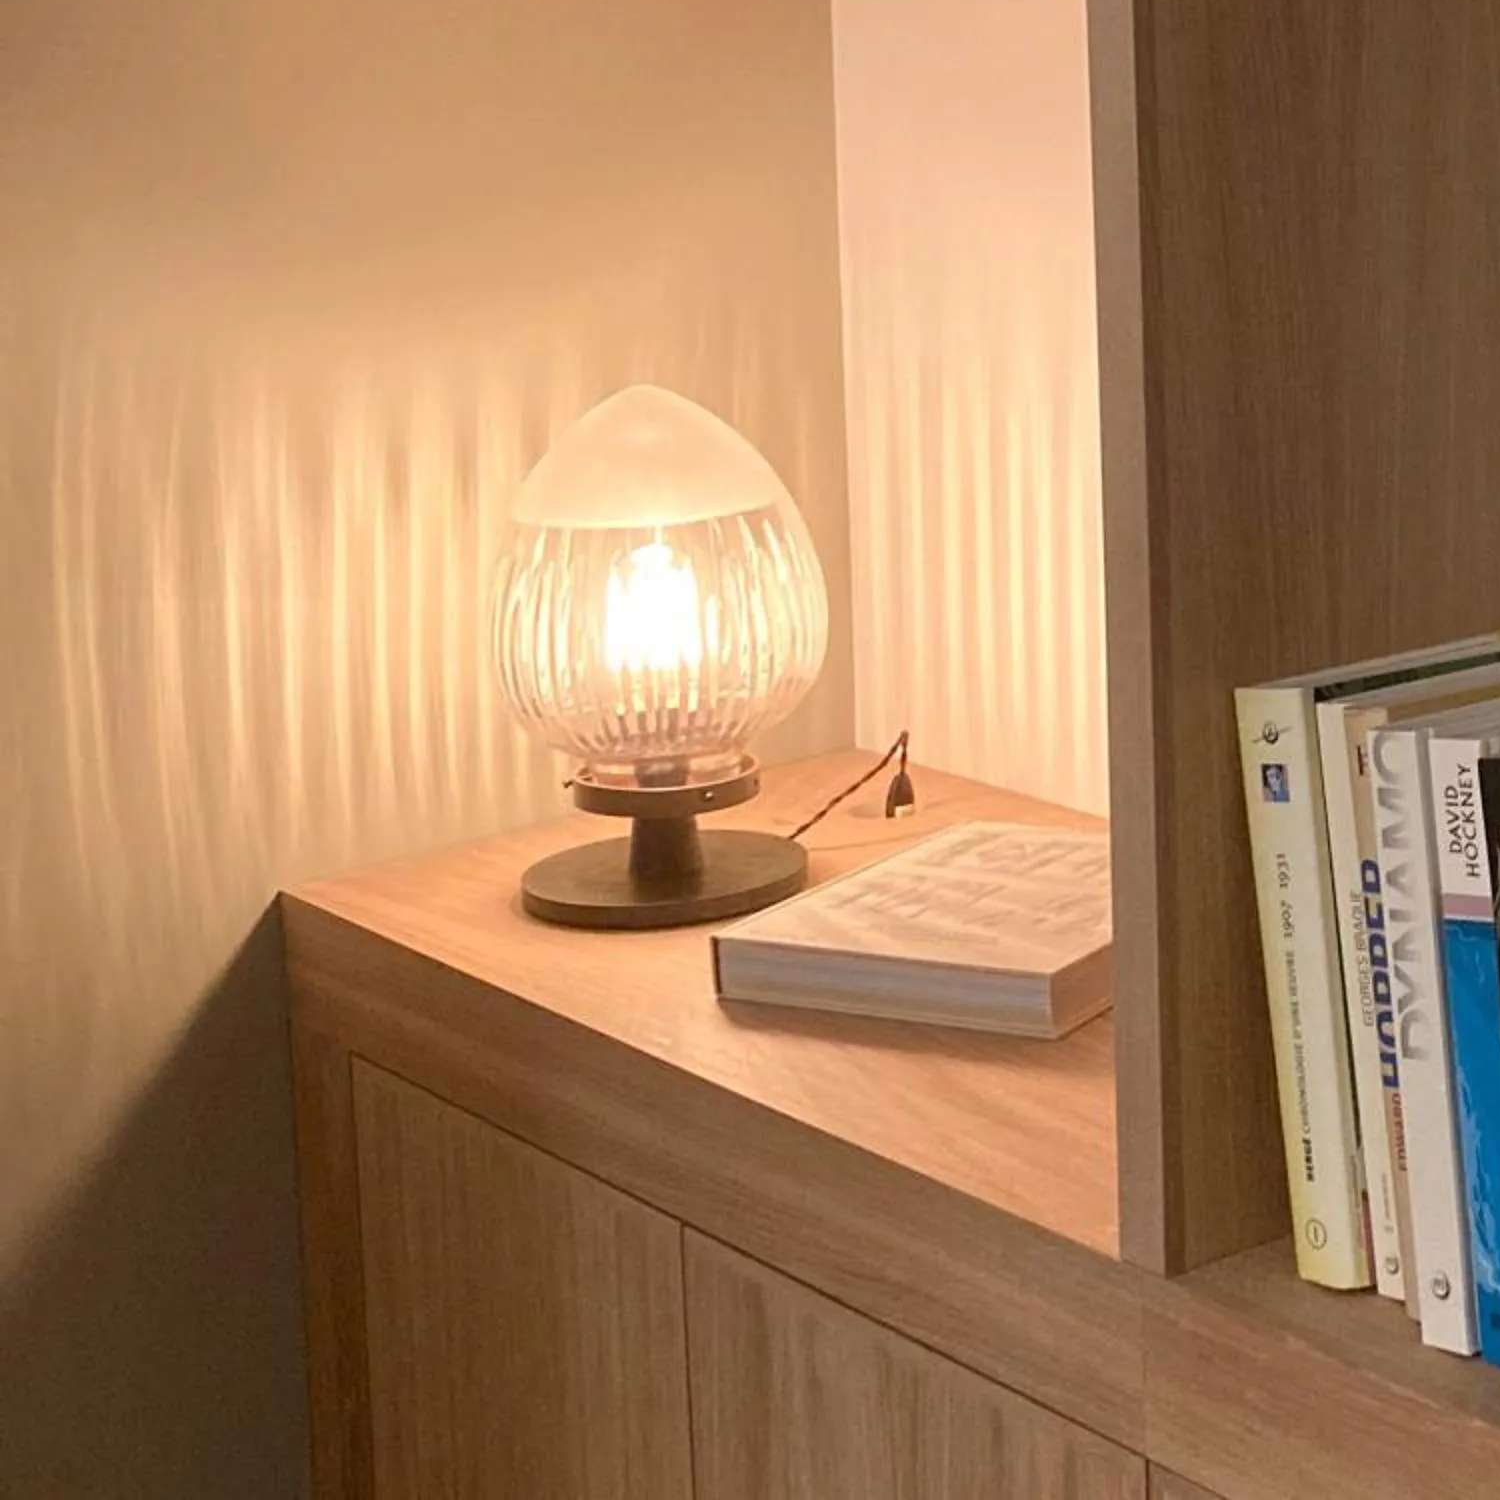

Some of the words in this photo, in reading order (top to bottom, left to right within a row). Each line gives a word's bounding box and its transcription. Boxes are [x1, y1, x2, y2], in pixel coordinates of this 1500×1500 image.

[1444, 784, 1463, 854] DAVID
[1457, 763, 1481, 879] HOCKNEY
[1276, 851, 1291, 889] 1931
[1373, 730, 1429, 1061] DYNAMO
[1280, 899, 1295, 939] 1907
[1357, 956, 1375, 1028] GEORGES
